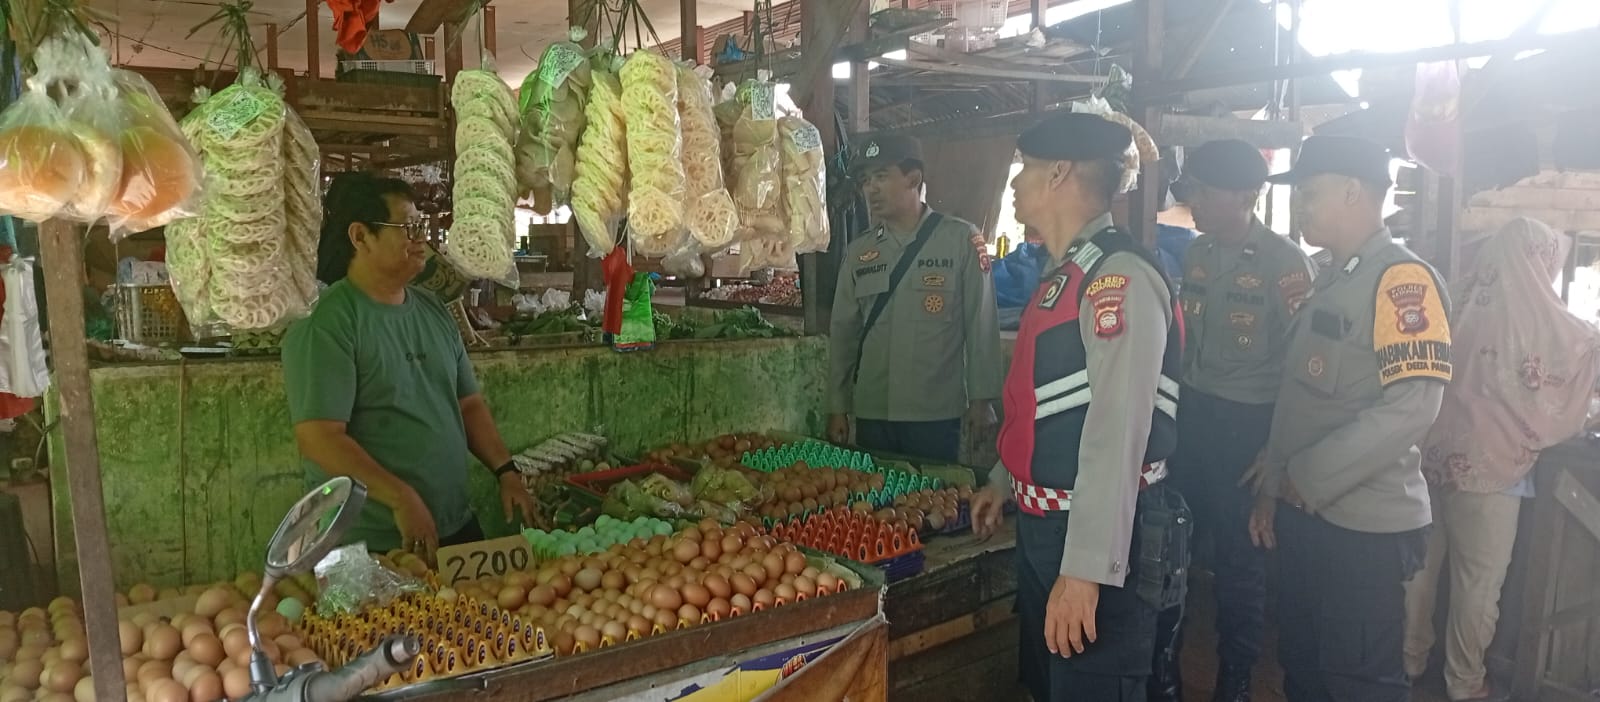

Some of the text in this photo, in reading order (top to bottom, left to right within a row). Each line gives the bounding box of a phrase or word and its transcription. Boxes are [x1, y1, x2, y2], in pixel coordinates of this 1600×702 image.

[917, 258, 954, 269] POLRI
[1406, 362, 1429, 371] DELTA
[446, 546, 528, 588] 2200
